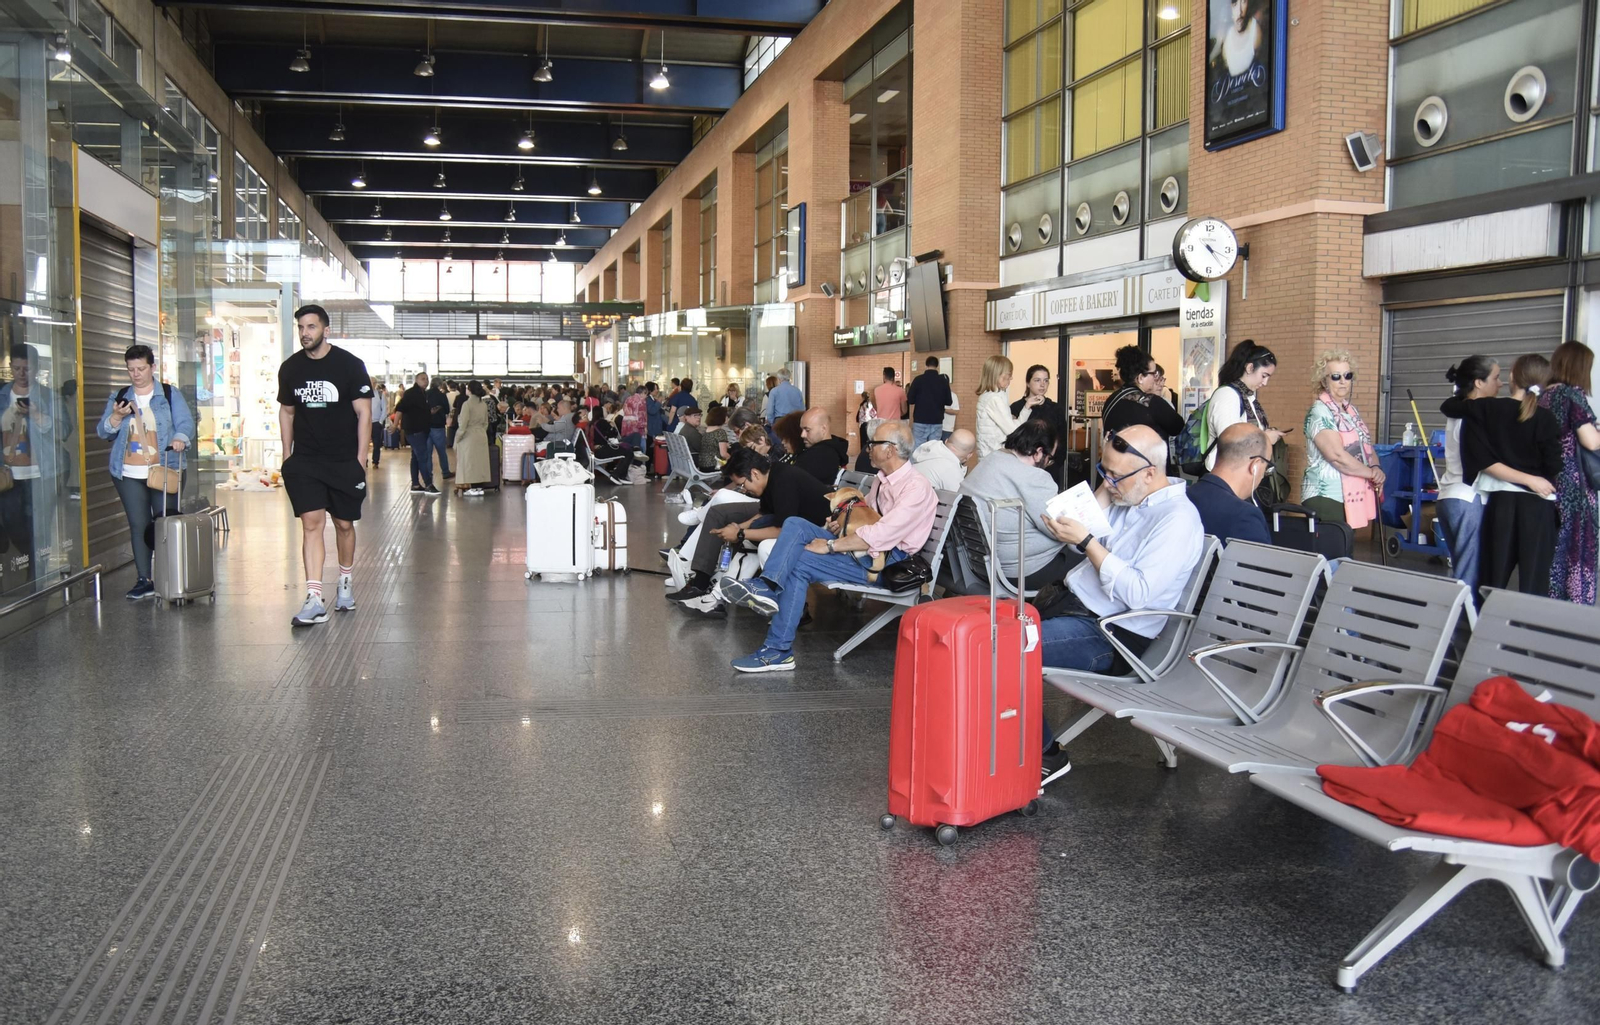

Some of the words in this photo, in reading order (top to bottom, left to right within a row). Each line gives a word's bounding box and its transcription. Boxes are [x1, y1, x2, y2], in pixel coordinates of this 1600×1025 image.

[1205, 266, 1212, 274] 6
[1148, 288, 1171, 304] CARTE
[1050, 297, 1078, 315] COFFEE
[1079, 298, 1085, 311] &
[1086, 290, 1119, 311] BAKERY
[1000, 311, 1014, 324] CARTE
[1186, 306, 1214, 321] tiendas
[306, 380, 323, 389] THE
[294, 388, 323, 396] NORTH
[301, 395, 323, 403] FACE
[1089, 405, 1096, 413] TU
